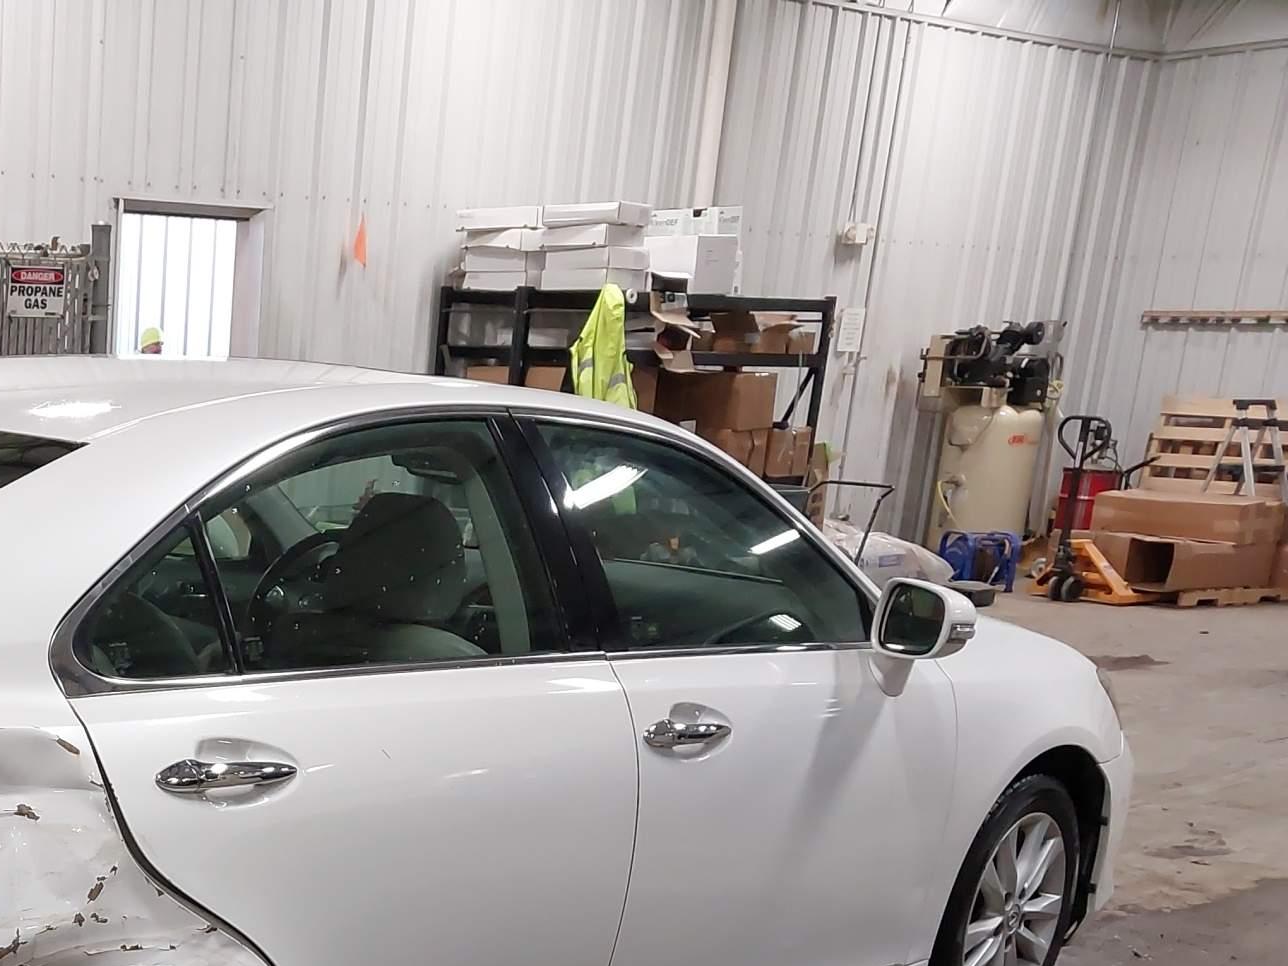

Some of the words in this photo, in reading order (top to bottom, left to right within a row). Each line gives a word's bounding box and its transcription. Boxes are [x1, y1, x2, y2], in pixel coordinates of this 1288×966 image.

[20, 272, 55, 281] DANGER
[10, 285, 64, 298] PROPANE
[24, 298, 48, 310] GAS
